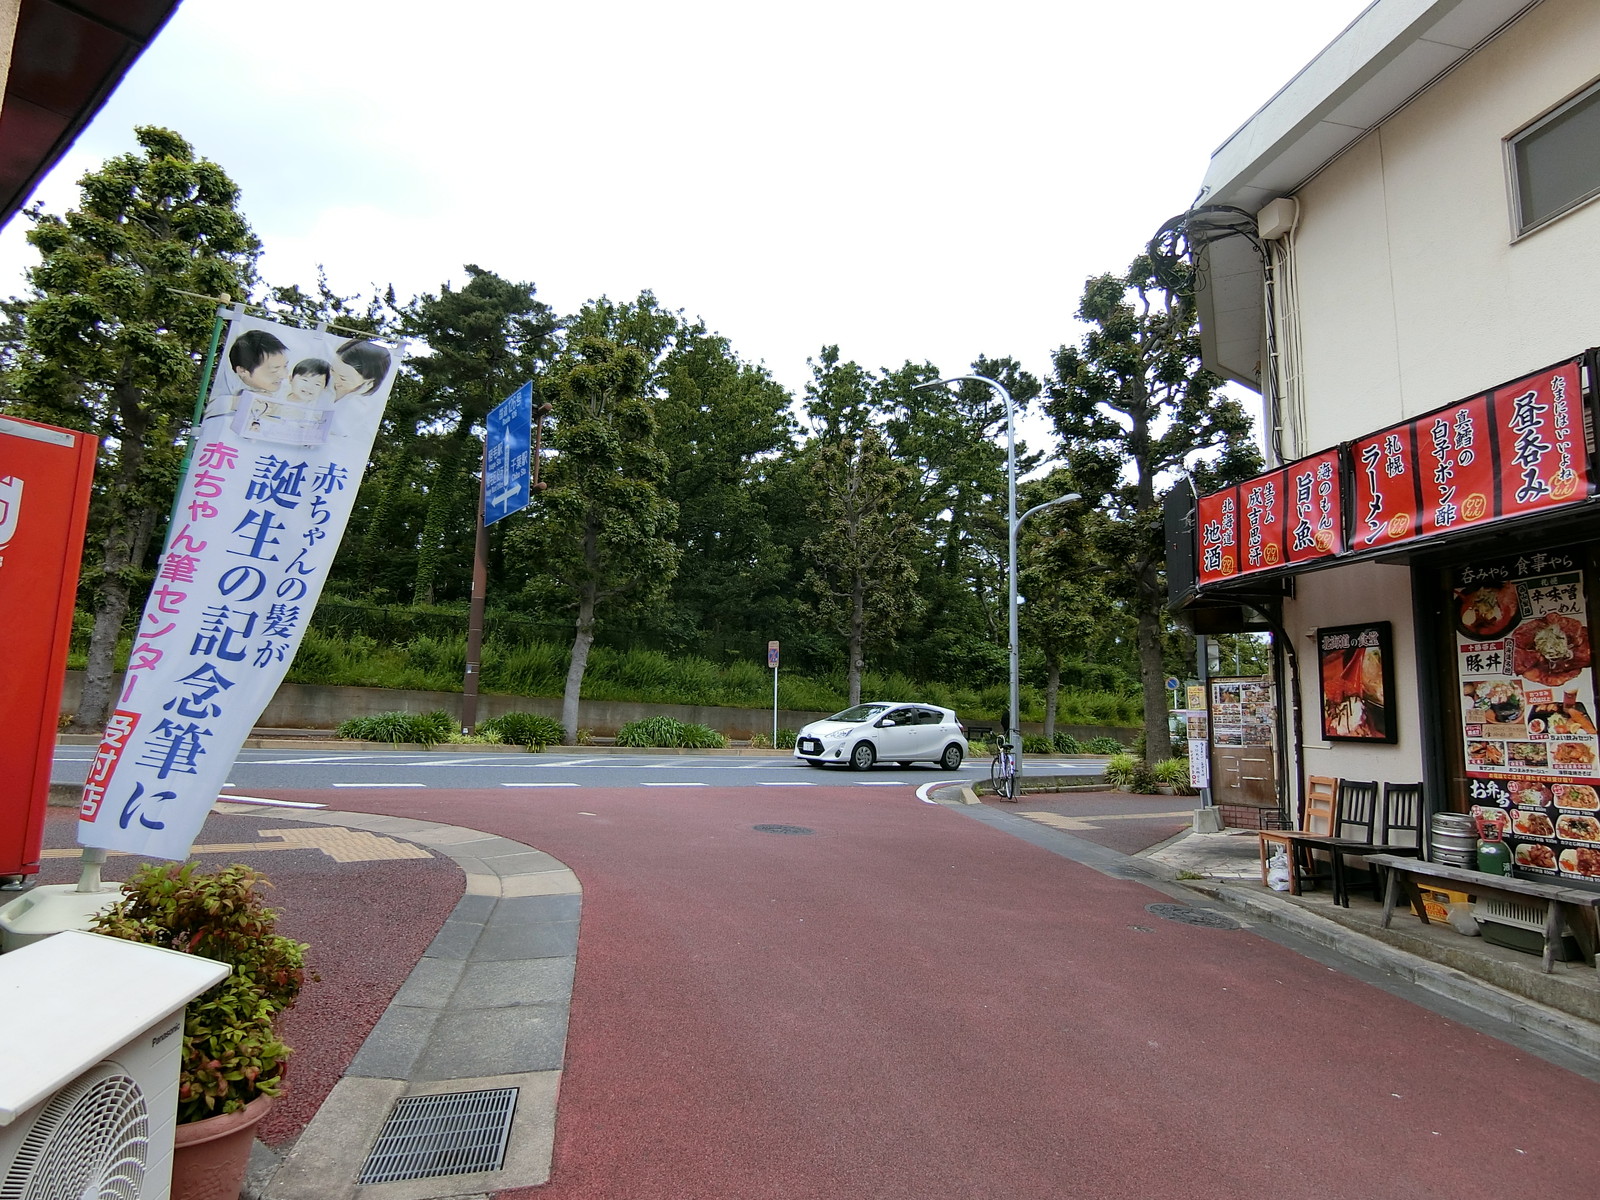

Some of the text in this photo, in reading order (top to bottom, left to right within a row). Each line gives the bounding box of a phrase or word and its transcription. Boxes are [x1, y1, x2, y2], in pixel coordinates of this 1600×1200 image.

[1384, 435, 1404, 478] 札幌
[1454, 409, 1474, 466] 真鱈の
[1508, 390, 1552, 503] 昼呑み
[1551, 375, 1573, 481] たまにはいいよね
[511, 450, 528, 472] 千葉駅
[1431, 418, 1457, 527] 白子ポン酢
[1222, 497, 1234, 547] 北海道
[1264, 482, 1275, 524] 生ラム
[1293, 472, 1316, 550] 旨い魚
[1317, 462, 1333, 530] 海のもん
[1362, 443, 1388, 545] ラーメン
[1203, 520, 1221, 572] 地酒
[1247, 487, 1263, 566] 成吉思汗
[121, 441, 239, 704] 赤ちゃん筆センター
[253, 462, 348, 669] 赤ちゃんの髪が
[1461, 553, 1573, 584] 呑みやら 食事やら
[1531, 585, 1578, 604] 辛味噌
[1539, 602, 1581, 616] らーめん
[118, 453, 308, 830] 誕生の記念筆に
[1466, 653, 1502, 672] 豚丼
[81, 714, 132, 817] 受付店
[1470, 780, 1510, 808] お弁当
[152, 1022, 180, 1048] Panasonic
